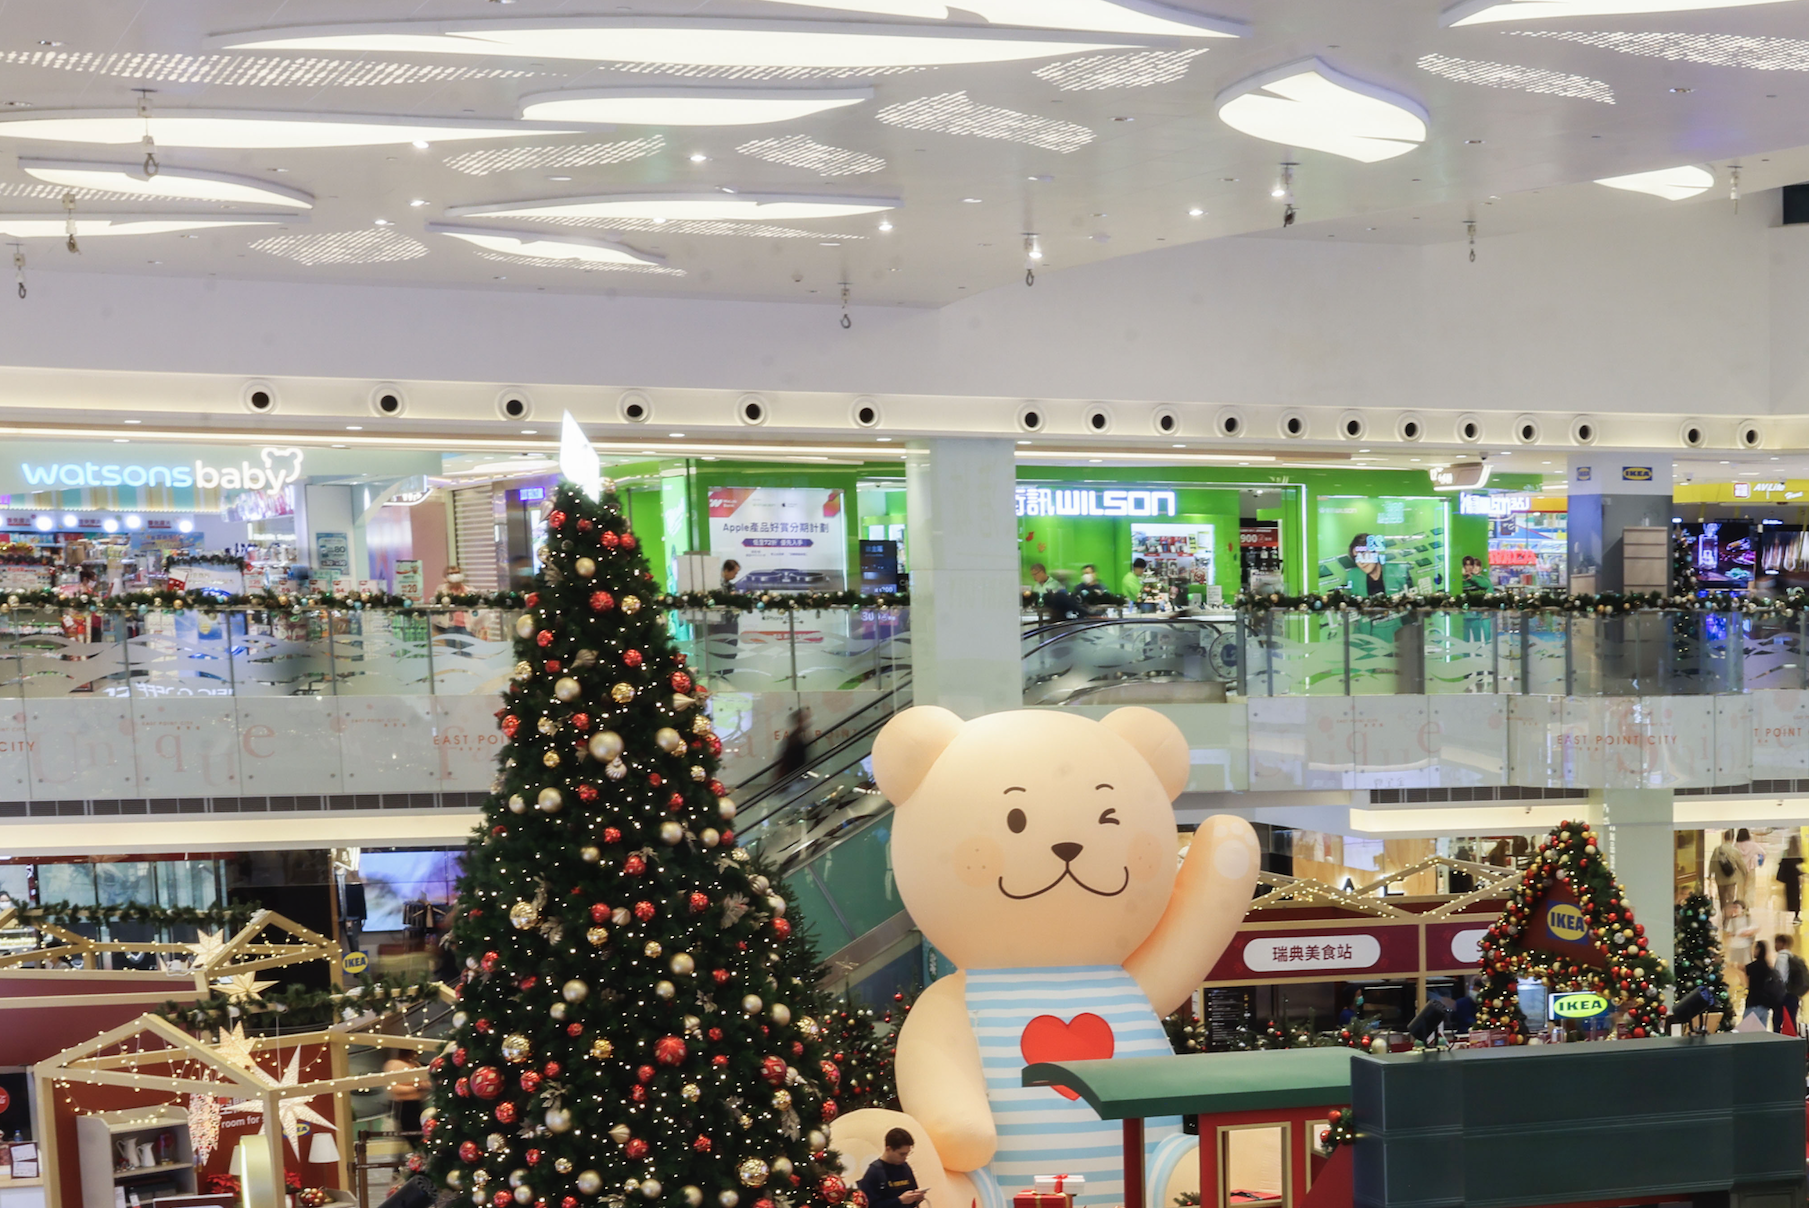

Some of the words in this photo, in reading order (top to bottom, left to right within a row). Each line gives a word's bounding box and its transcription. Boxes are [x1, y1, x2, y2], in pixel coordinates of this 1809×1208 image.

[1624, 469, 1651, 479] IKEA
[1056, 490, 1176, 516] WILSON
[1765, 727, 1802, 738] POINT
[432, 735, 469, 746] EAST
[1556, 736, 1588, 746] EAST
[1596, 736, 1639, 746] POINT
[1647, 735, 1678, 746] CITY
[1550, 911, 1586, 933] IKEA
[1272, 943, 1353, 963] 瑞典美食站
[345, 957, 366, 968] IKEA
[1558, 996, 1603, 1012] IKEA
[221, 1118, 246, 1129] room
[246, 1115, 260, 1125] for
